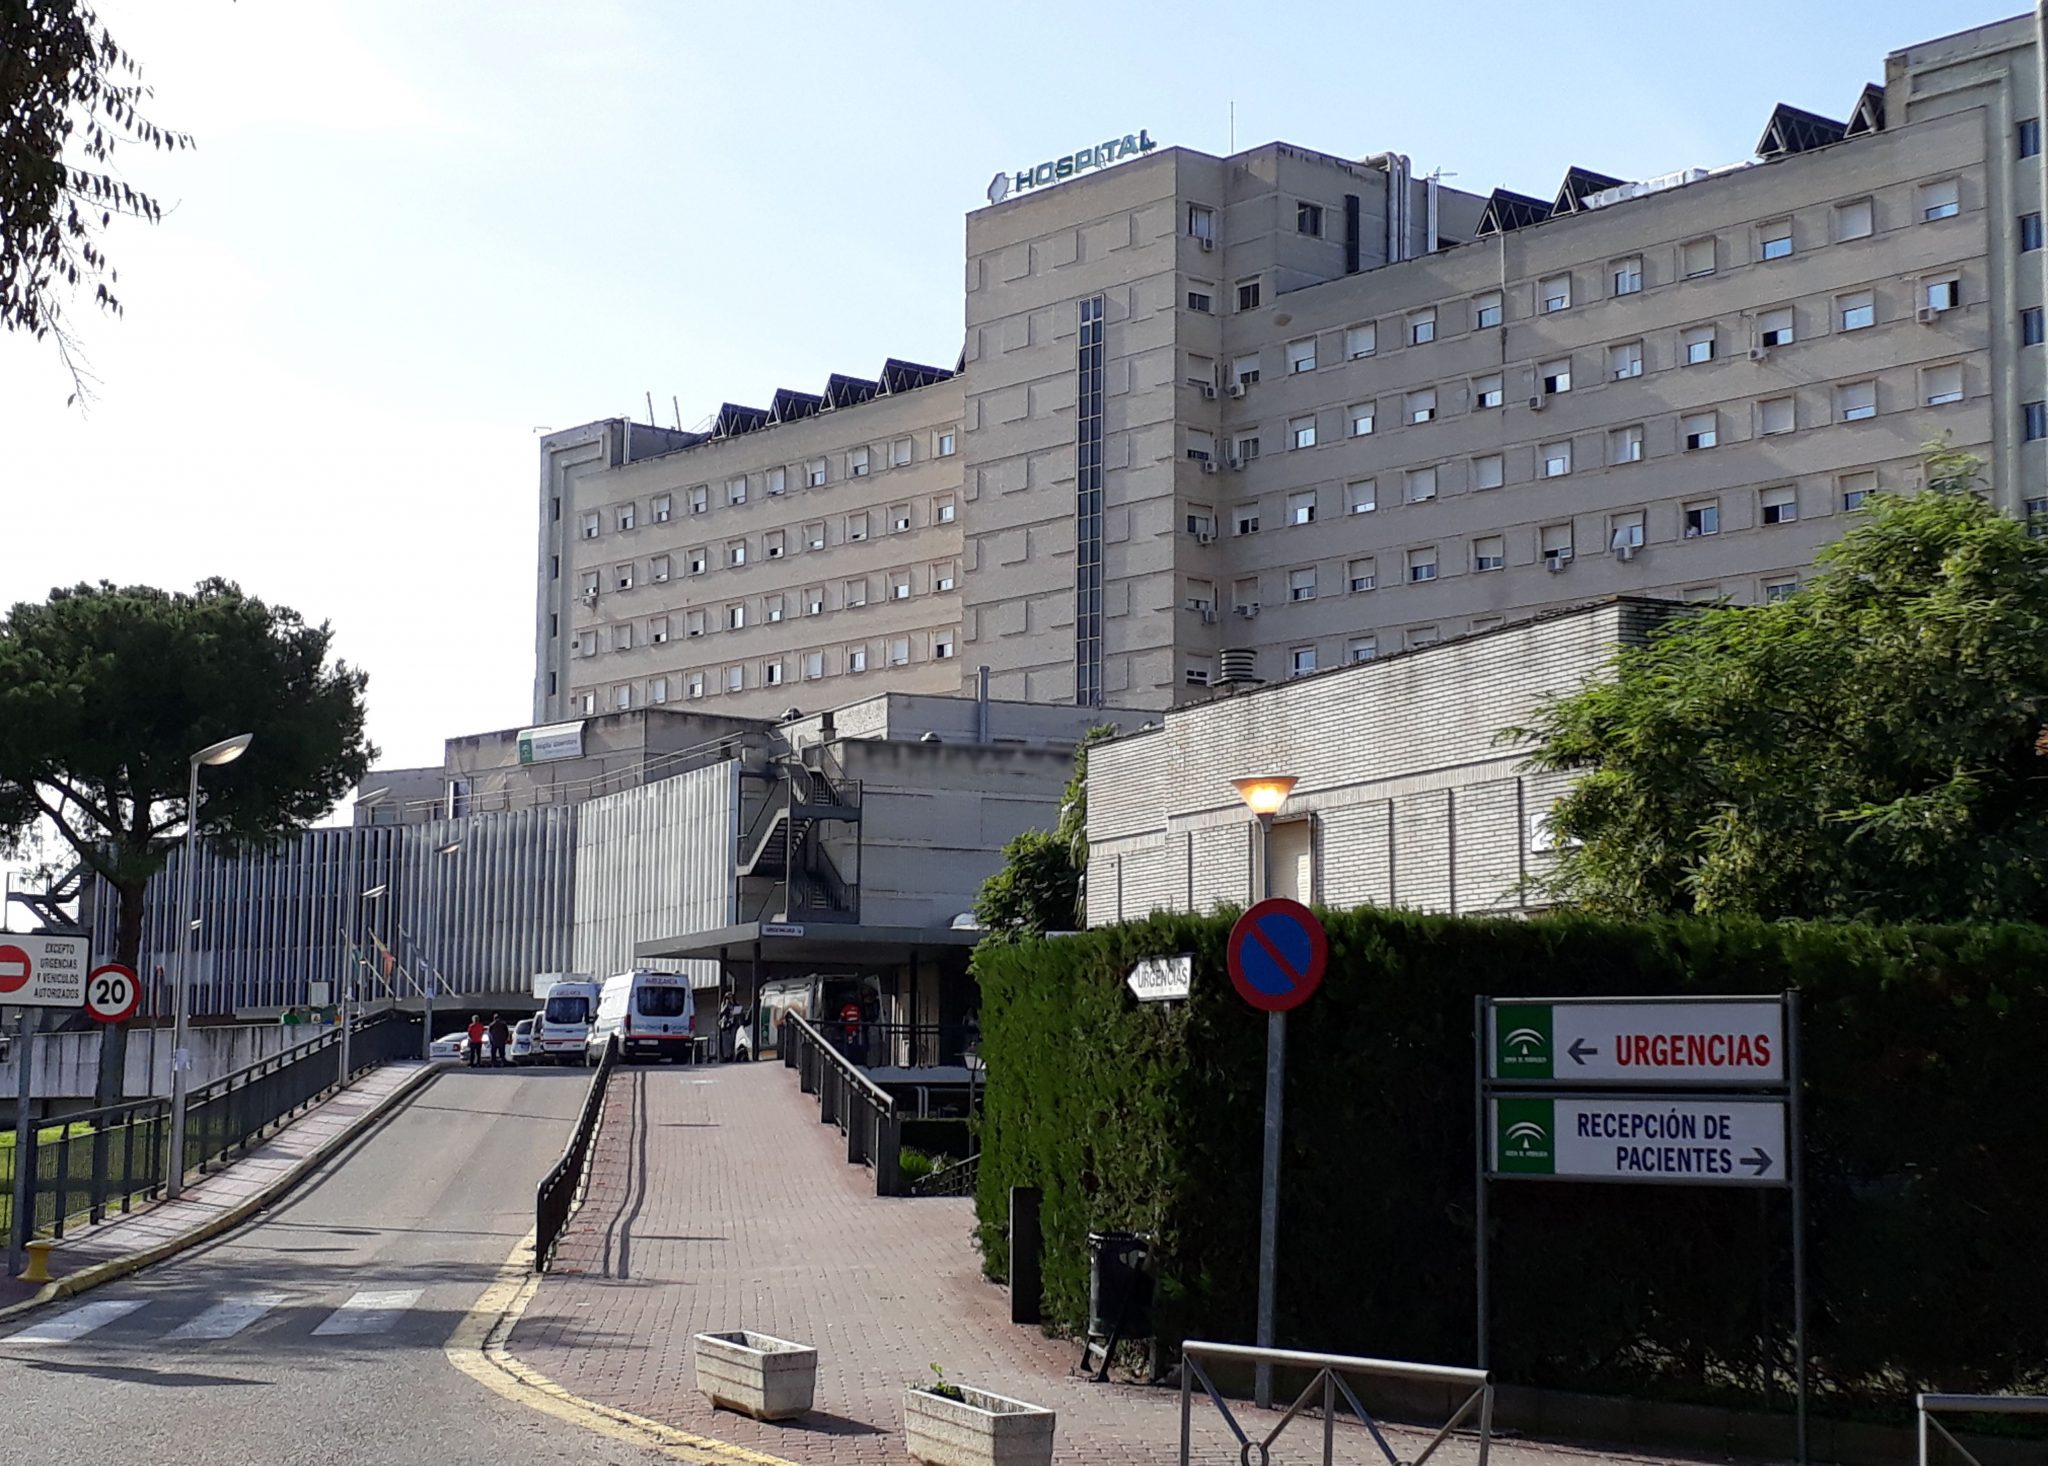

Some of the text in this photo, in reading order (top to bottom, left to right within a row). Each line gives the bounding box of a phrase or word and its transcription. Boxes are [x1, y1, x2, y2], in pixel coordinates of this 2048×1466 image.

[1016, 129, 1157, 192] HOSPITAL
[45, 943, 75, 954] EXCEPTO
[40, 957, 77, 970] URGENCIAS
[1137, 966, 1188, 988] URGENCIAS
[34, 987, 79, 999] AUTORIZADOS
[96, 979, 126, 1004] 20
[1615, 1034, 1771, 1067] URGENCIAS
[1577, 1107, 1732, 1140] RECEPCIÓN DE
[1616, 1146, 1733, 1174] PACIENTES
